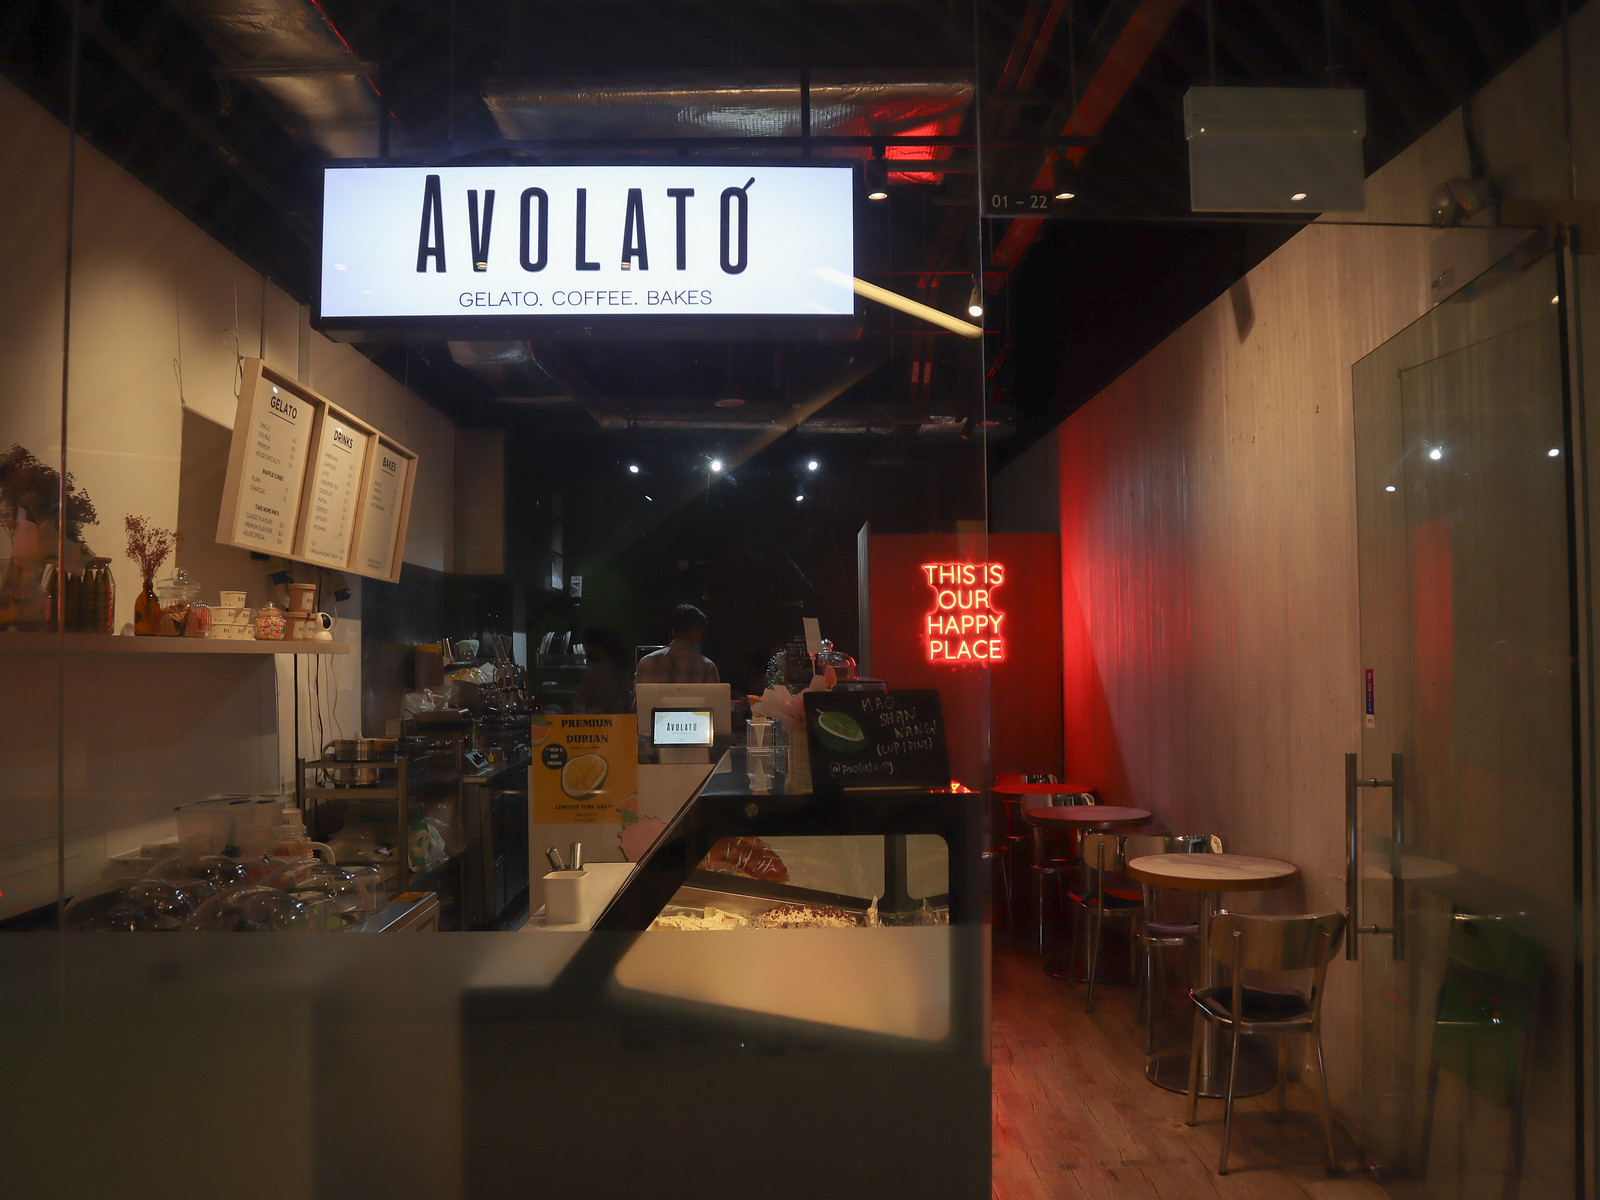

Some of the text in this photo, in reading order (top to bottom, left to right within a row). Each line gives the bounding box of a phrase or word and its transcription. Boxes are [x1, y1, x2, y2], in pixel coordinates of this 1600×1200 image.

[992, 194, 1008, 208] 01
[1030, 195, 1048, 209] 22
[459, 290, 712, 307] GELATO. COFFEE. BAKES
[270, 396, 298, 419] GELATO
[333, 430, 354, 449] DRINKS
[382, 457, 397, 472] BAKES
[924, 565, 1003, 584] THIS IS
[938, 590, 990, 609] OUR
[928, 615, 1003, 634] HAPPY
[930, 640, 1002, 660] PLACE
[561, 719, 613, 728] PREMIUM
[566, 734, 609, 743] DURIAN
